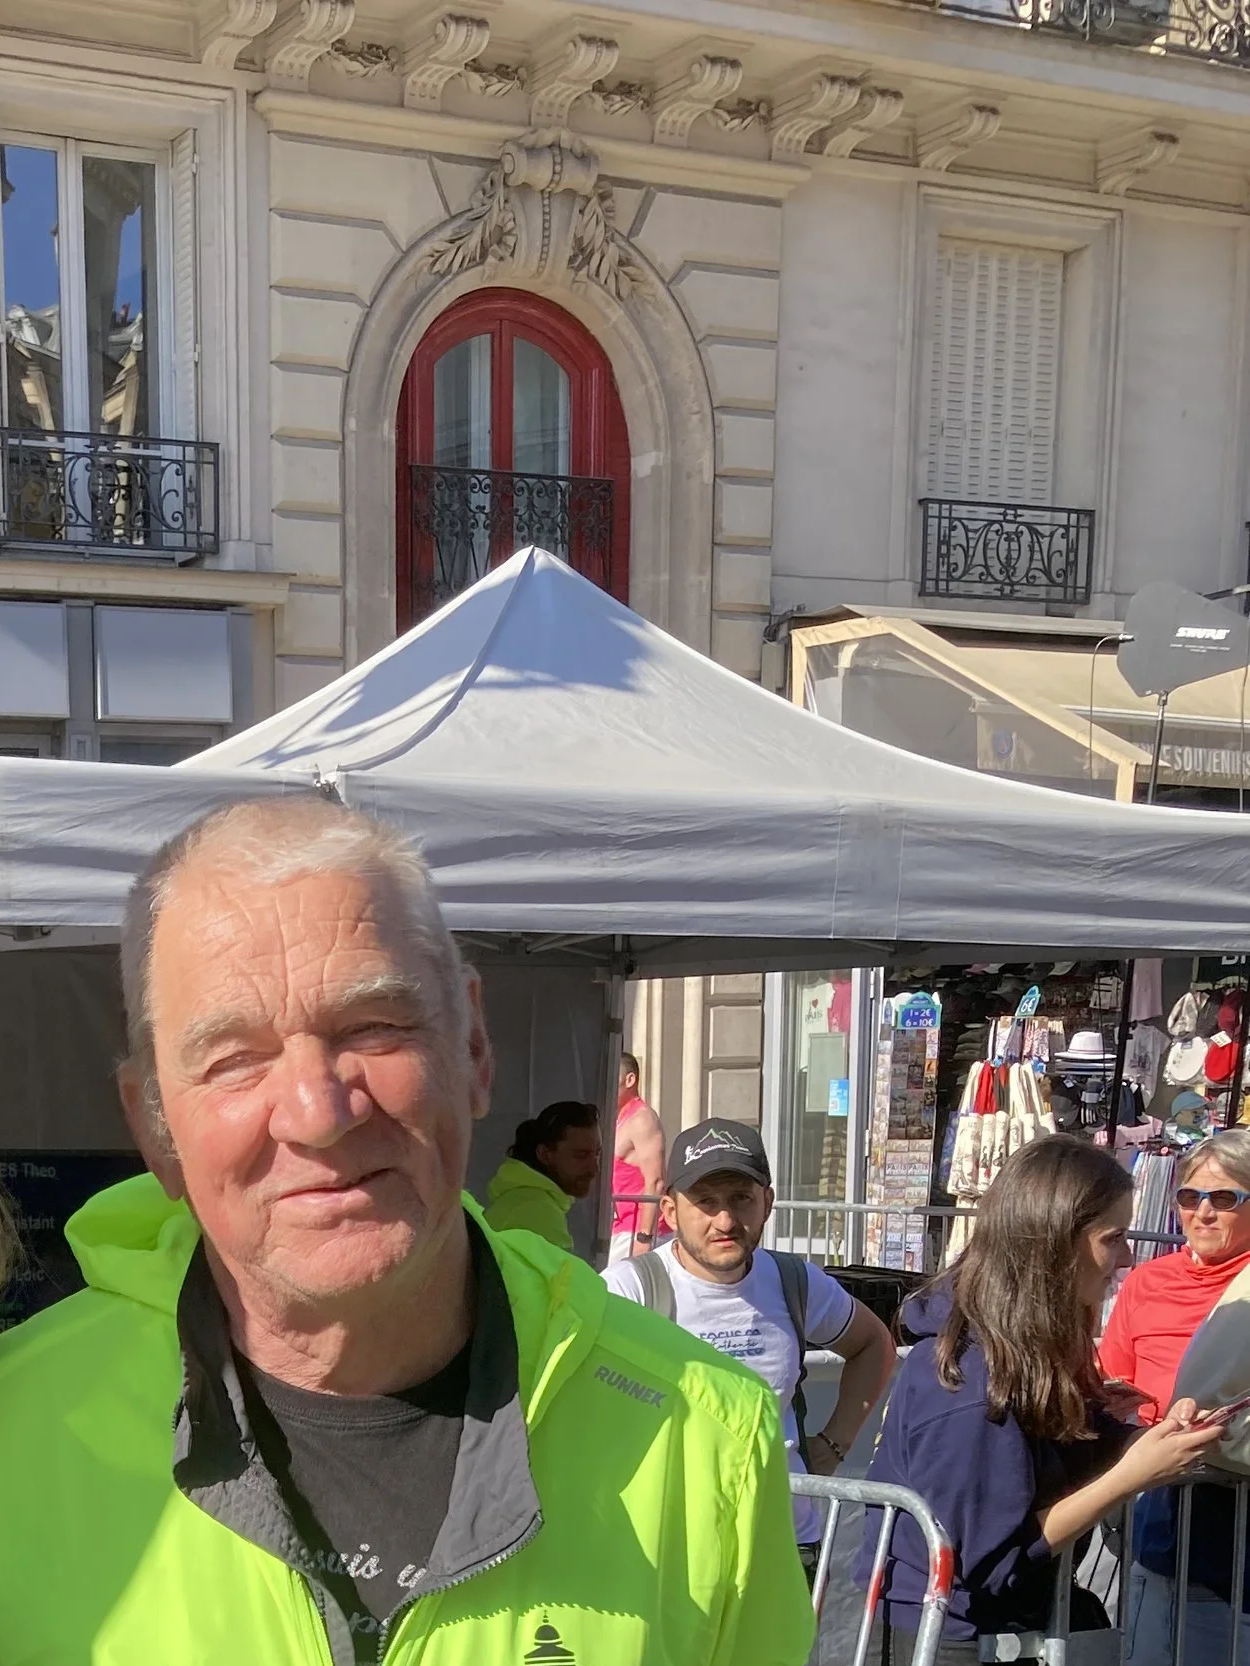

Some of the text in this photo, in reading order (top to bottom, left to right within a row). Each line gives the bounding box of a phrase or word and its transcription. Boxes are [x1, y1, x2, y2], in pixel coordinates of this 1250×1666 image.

[1020, 998, 1036, 1013] 6€
[920, 1008, 931, 1017] 2€
[905, 1018, 912, 1027] 6
[919, 1018, 934, 1027] 10€
[21, 1161, 57, 1179] Theo
